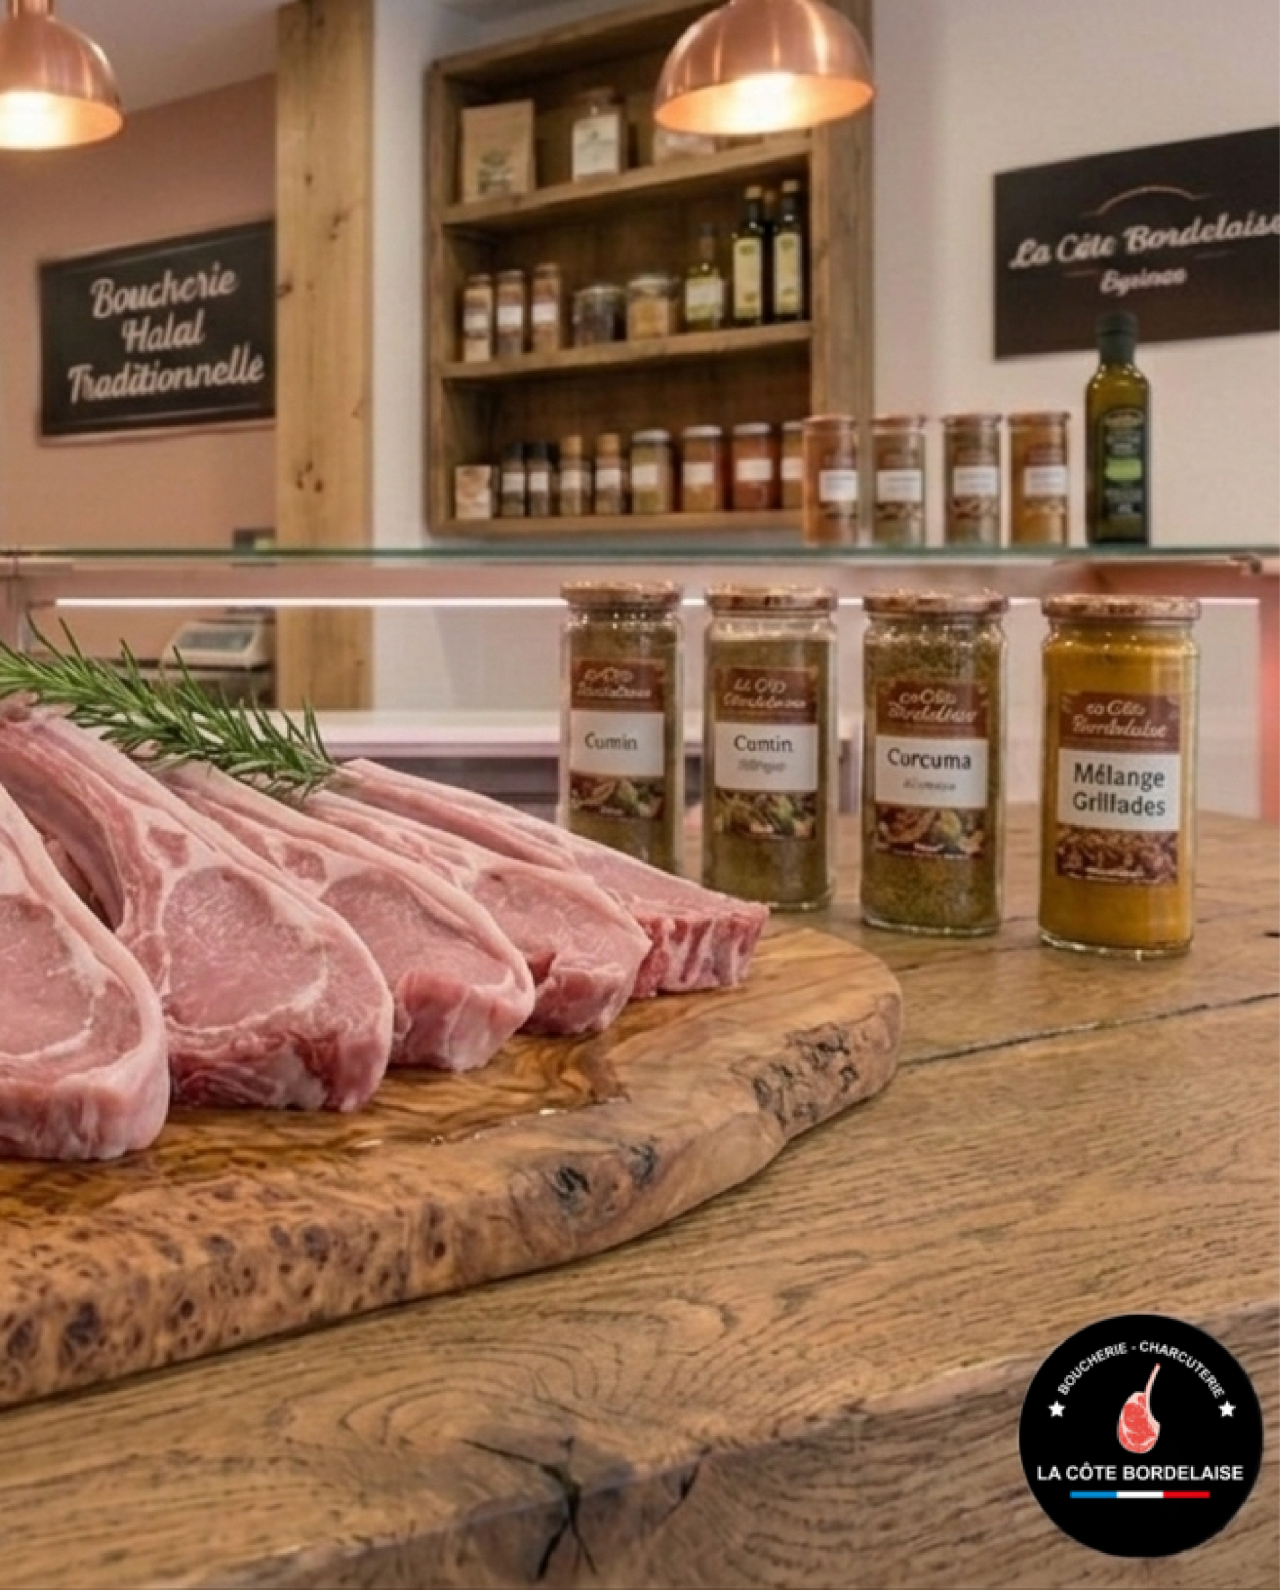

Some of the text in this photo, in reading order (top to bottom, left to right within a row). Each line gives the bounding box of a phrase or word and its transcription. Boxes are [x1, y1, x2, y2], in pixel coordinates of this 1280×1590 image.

[1007, 237, 1051, 269] La
[89, 260, 237, 320] Boucherie
[122, 307, 206, 353] Halal
[67, 343, 265, 404] Traditionnelle
[886, 746, 972, 770] Curcuma
[1073, 762, 1166, 793] Mélange
[1072, 791, 1166, 817] Grillades
